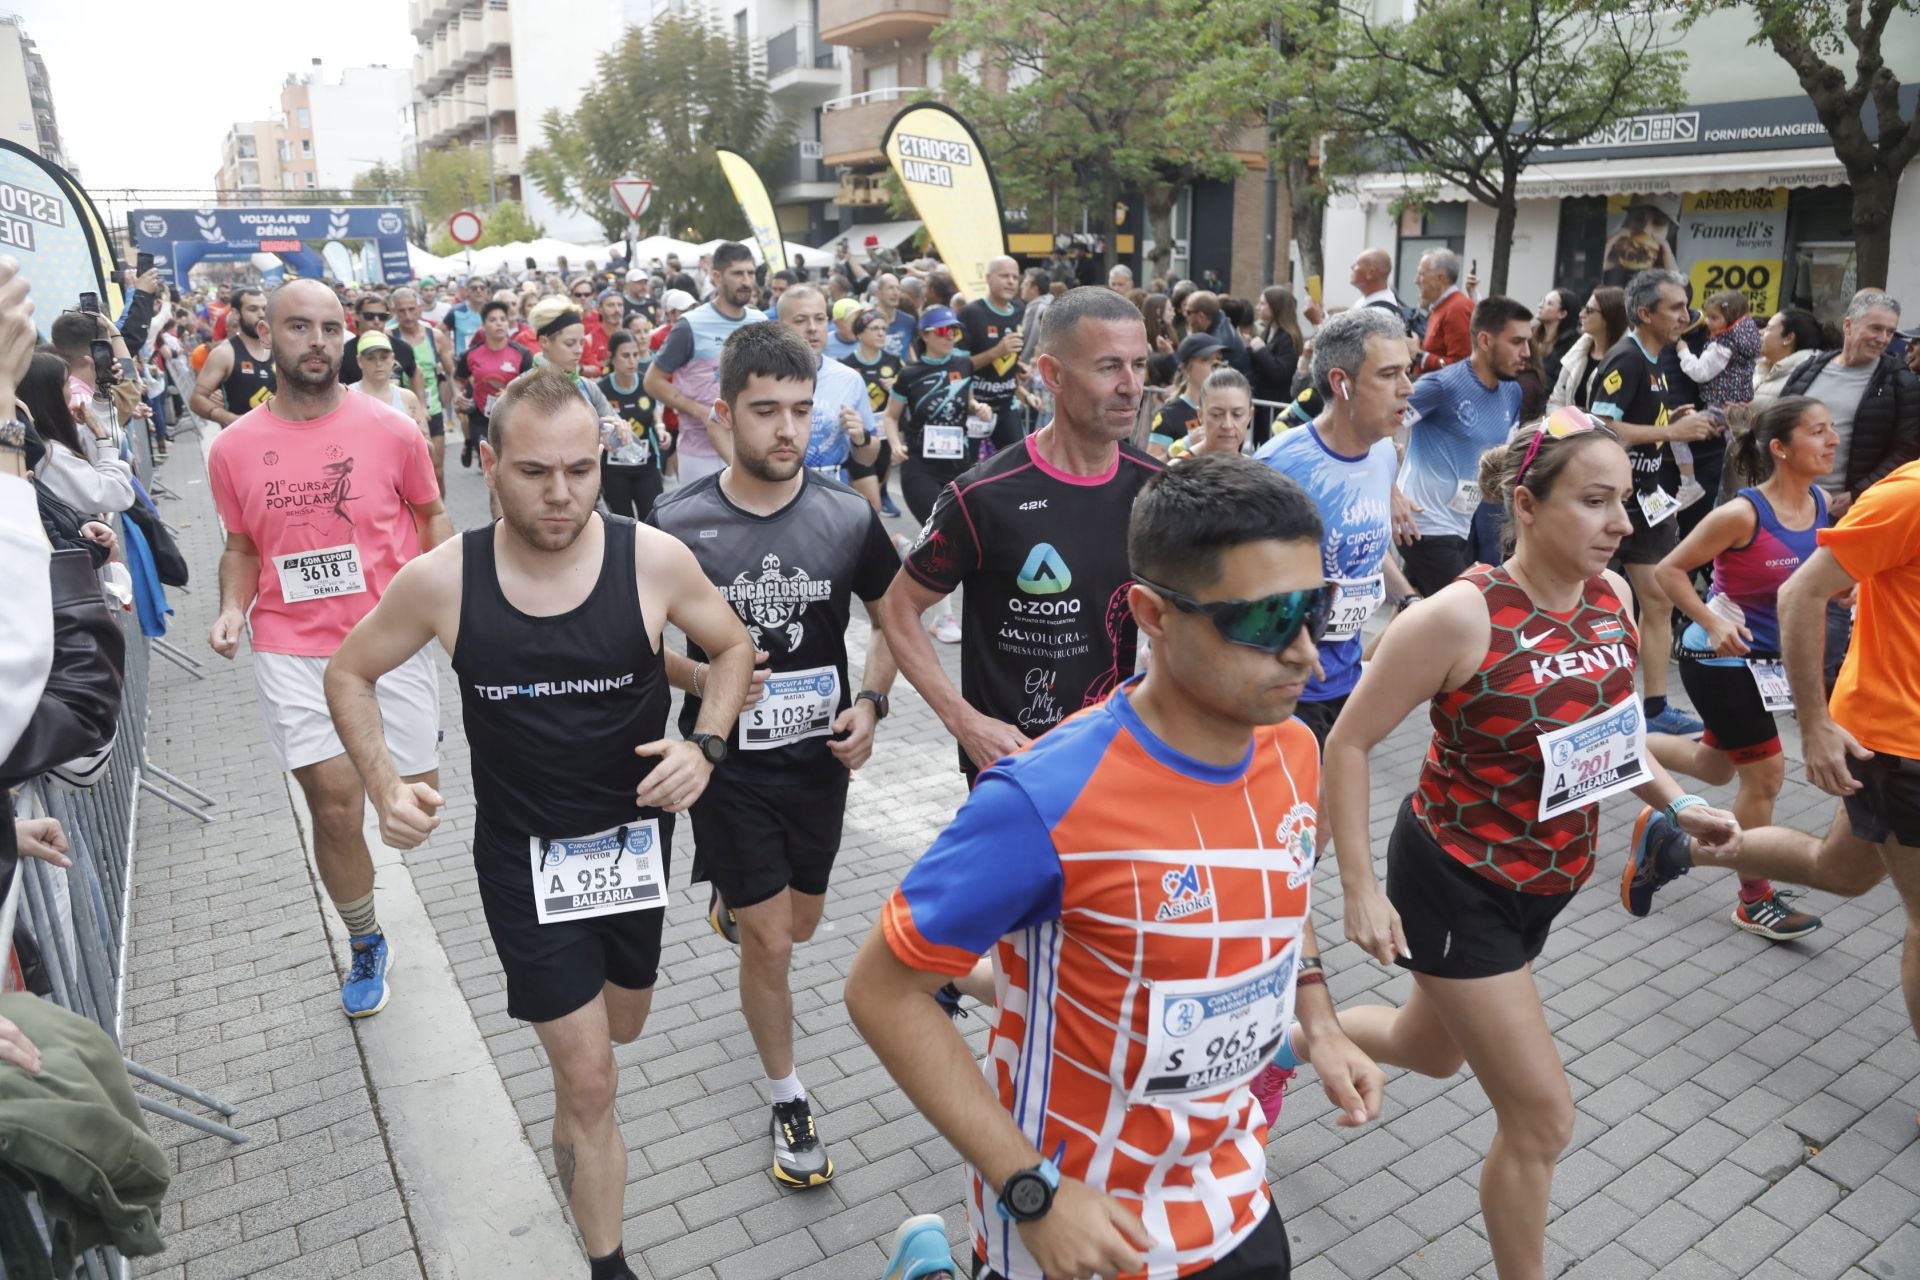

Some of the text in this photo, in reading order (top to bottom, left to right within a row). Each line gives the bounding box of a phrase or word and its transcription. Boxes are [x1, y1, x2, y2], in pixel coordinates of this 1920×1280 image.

[1694, 198, 1773, 210] APERTURA
[239, 214, 275, 224] VOLTA
[287, 215, 310, 224] PEU
[256, 224, 297, 237] DÉNIA
[1690, 221, 1774, 239] Fanneli's
[1736, 240, 1773, 249] burgers
[1705, 265, 1770, 290] 200
[288, 482, 330, 493] CURSA
[266, 493, 331, 510] POPULAR
[1018, 499, 1048, 511] 42K
[1346, 528, 1386, 545] CIRCUIT
[303, 552, 350, 565] SOM ESPORT
[1350, 546, 1360, 556] A
[301, 563, 341, 582] 3618
[1343, 606, 1367, 622] 720
[998, 641, 1089, 659] EMPRESA CONSTRUCTORA
[1530, 643, 1633, 684] KENYA
[474, 673, 634, 700] TOP4RUNNING
[771, 680, 796, 689] CIRCUIT
[1032, 691, 1056, 712] My
[753, 704, 815, 727] S 1035
[1586, 739, 1609, 753] GEMMA
[1554, 773, 1566, 791] A
[1577, 750, 1611, 782] 201
[602, 842, 620, 850] ALTA
[550, 865, 622, 894] A 955
[1157, 893, 1212, 920] Asioka
[1165, 1021, 1258, 1072] S 965
